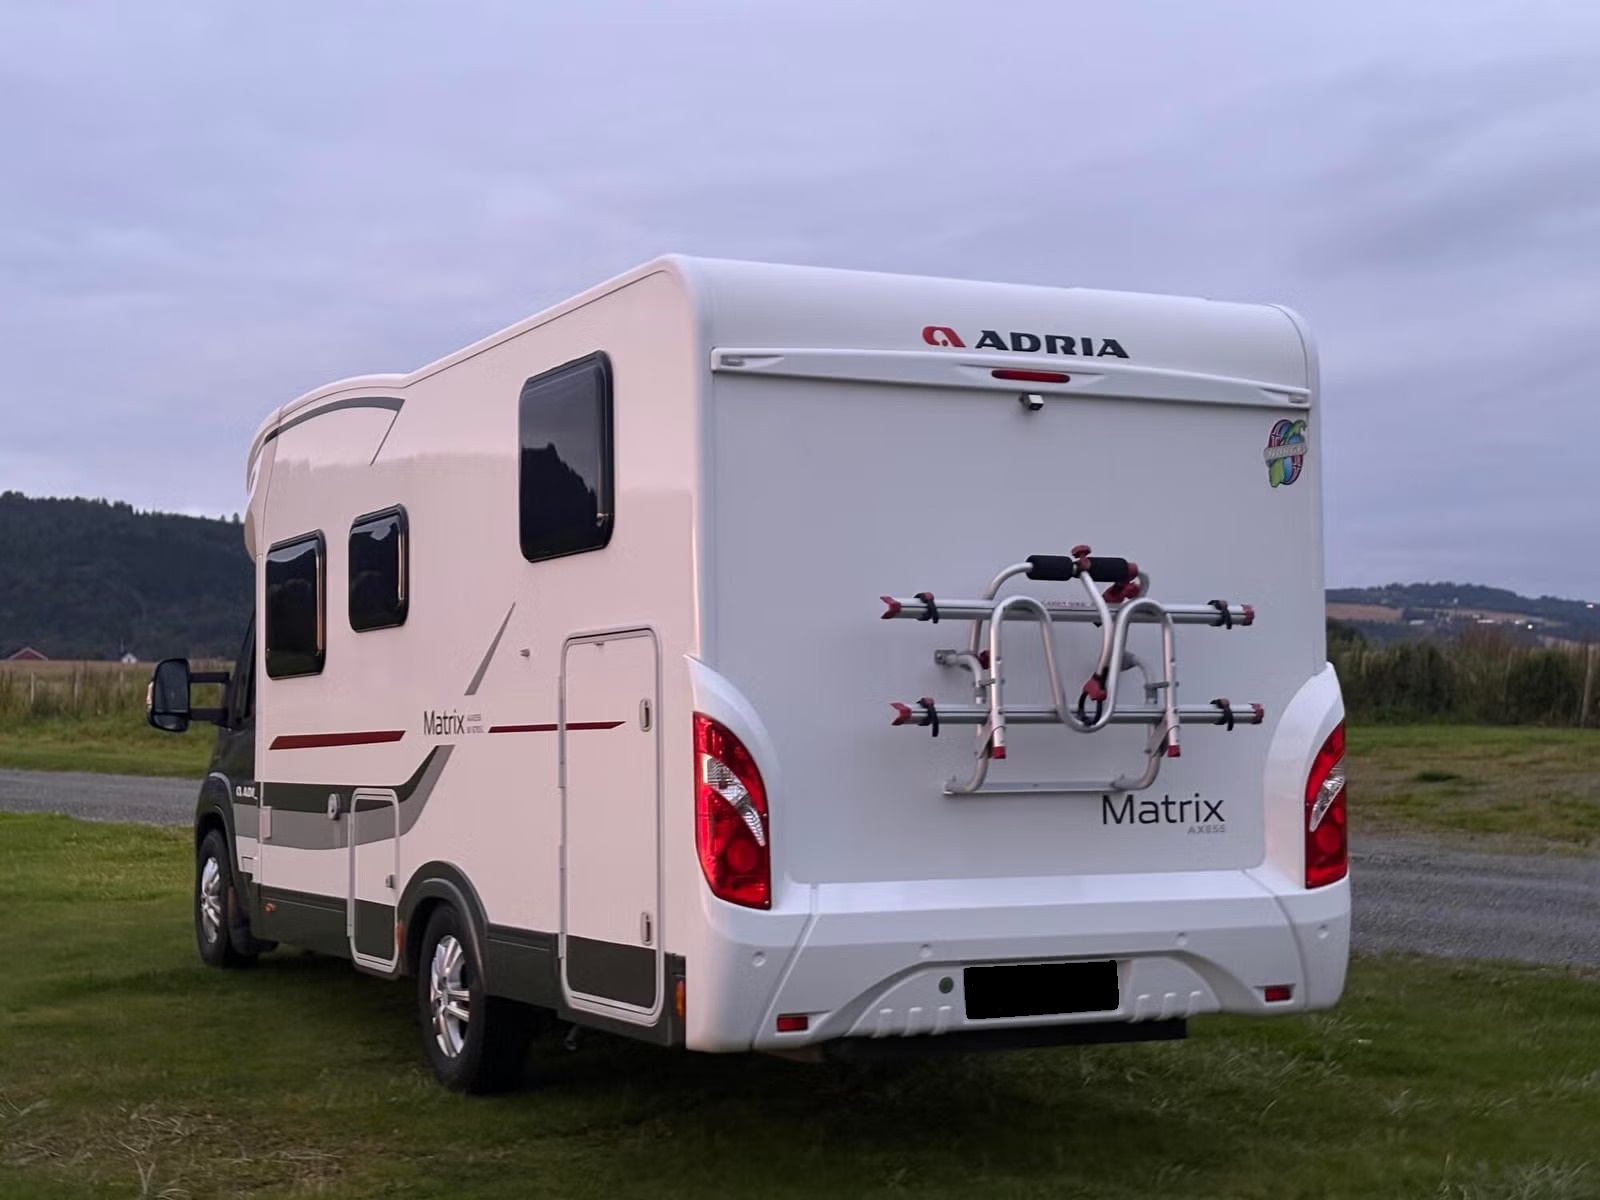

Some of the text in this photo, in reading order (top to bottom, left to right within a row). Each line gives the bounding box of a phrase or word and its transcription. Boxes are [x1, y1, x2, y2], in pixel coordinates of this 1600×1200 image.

[975, 330, 1130, 359] ADRIA
[423, 708, 465, 735] Matrix
[1102, 793, 1225, 825] Matrix
